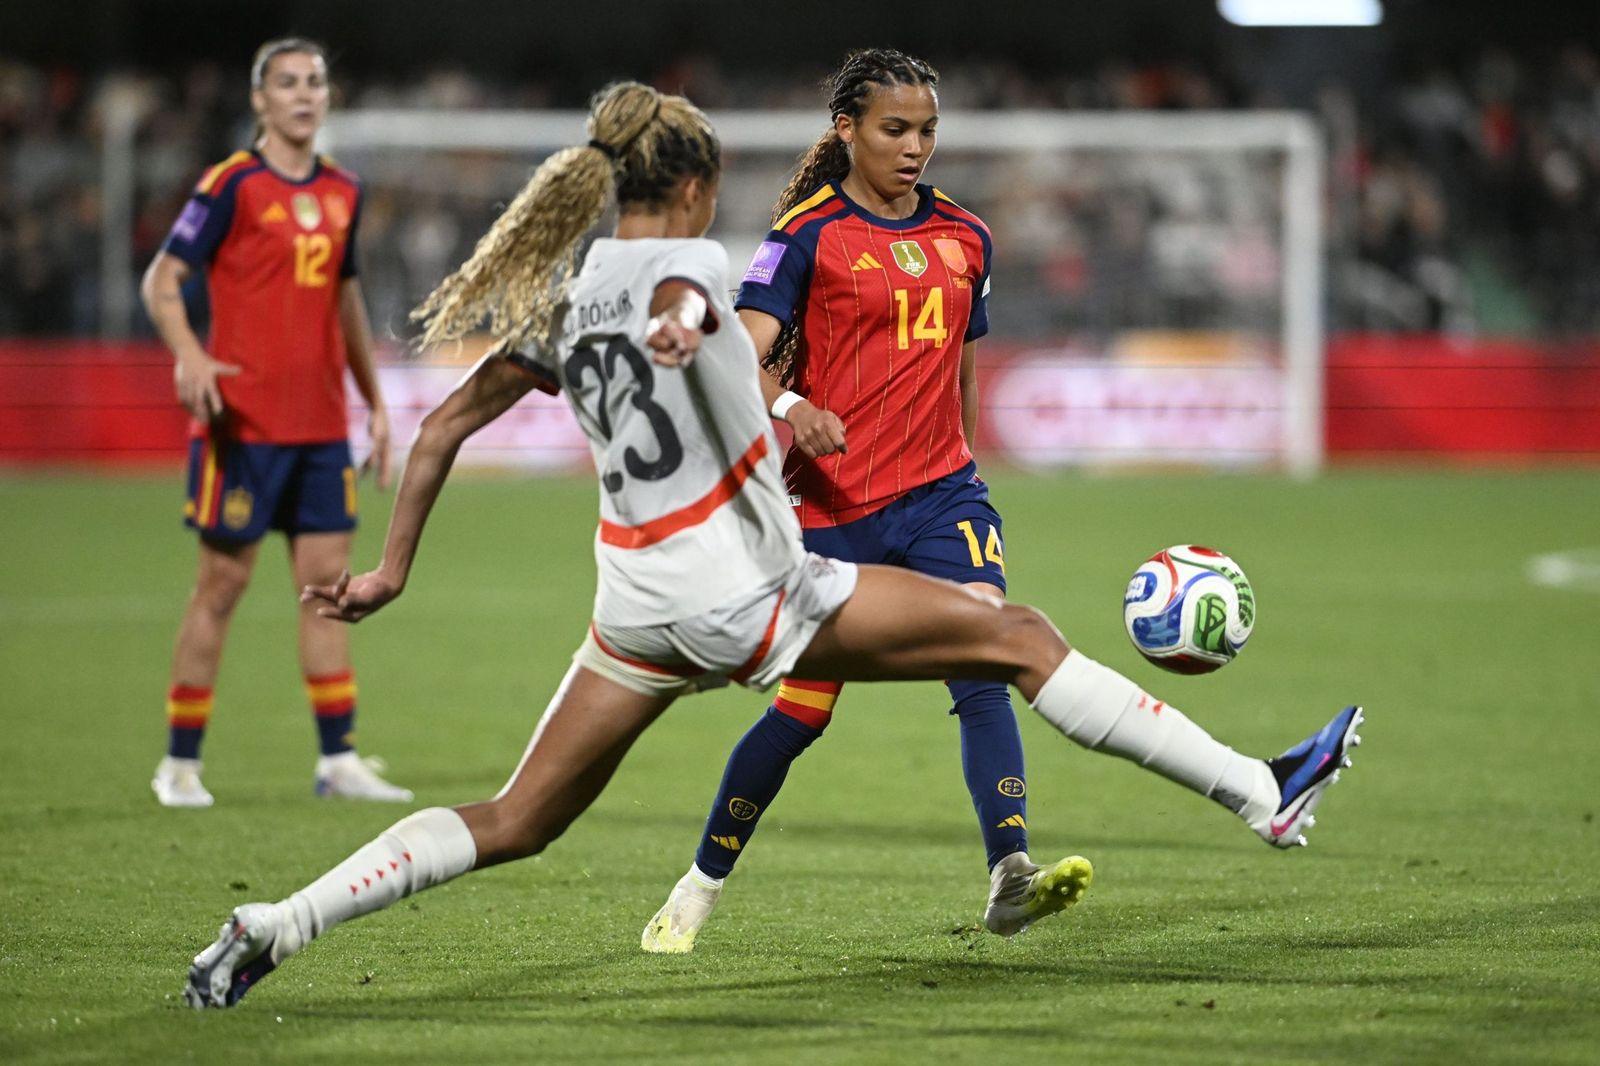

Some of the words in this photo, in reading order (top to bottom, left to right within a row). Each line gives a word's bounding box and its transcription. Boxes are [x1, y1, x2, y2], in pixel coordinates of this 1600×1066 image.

[293, 233, 332, 288] 12
[895, 287, 947, 350] 14
[565, 333, 684, 493] 23
[957, 520, 1006, 576] 14
